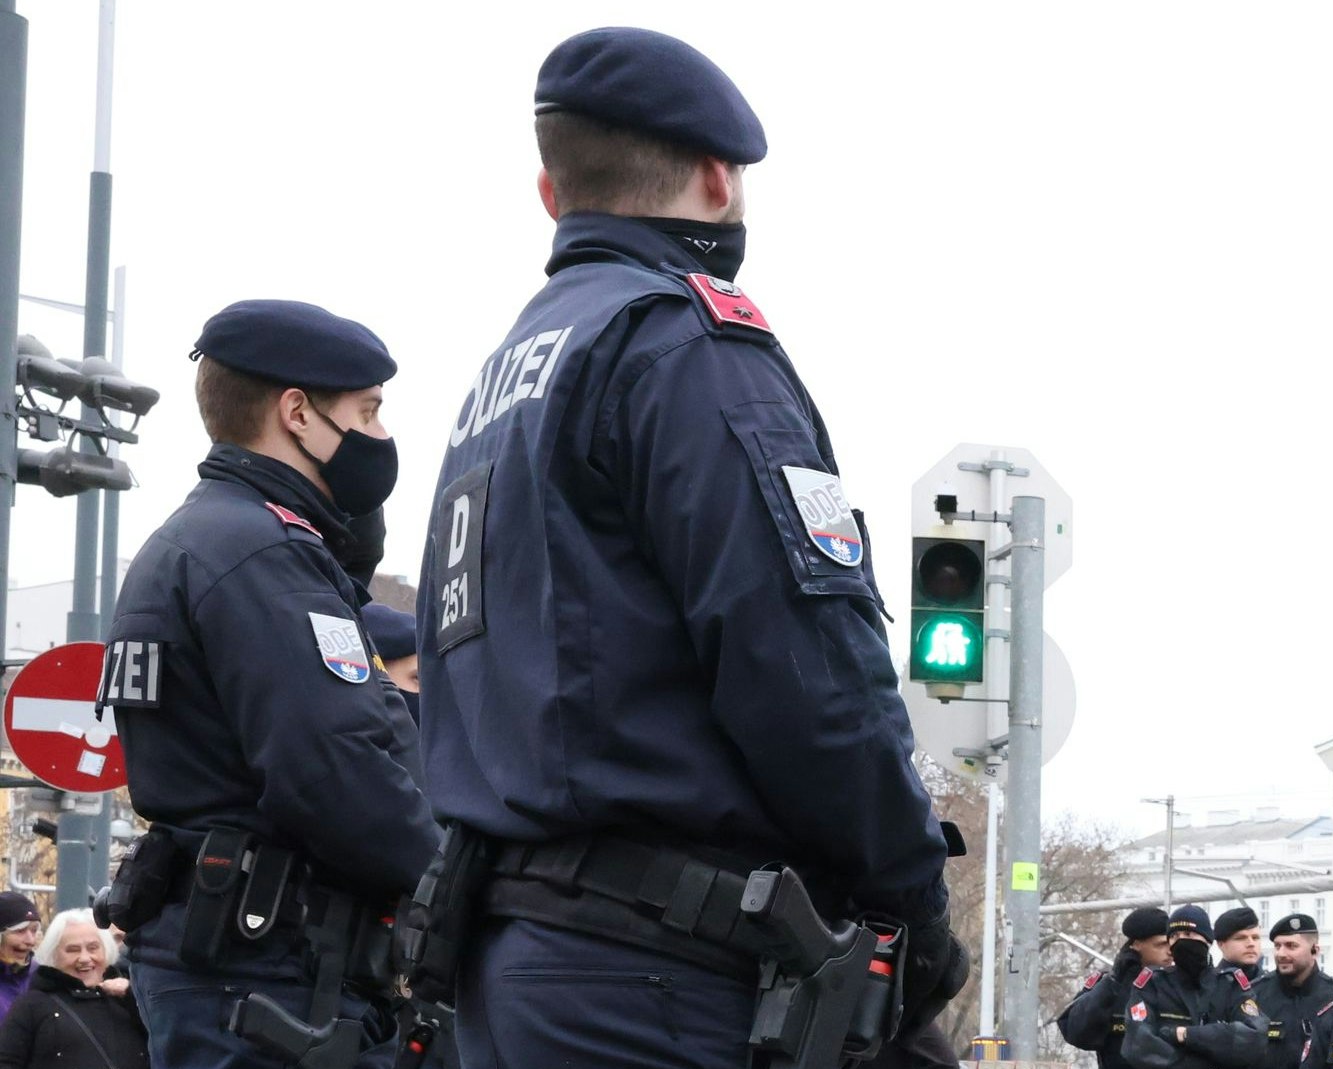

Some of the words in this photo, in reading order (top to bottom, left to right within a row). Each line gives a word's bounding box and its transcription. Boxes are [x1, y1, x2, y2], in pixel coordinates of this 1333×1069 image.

[451, 325, 574, 448] OLIZEI
[448, 494, 470, 569] D
[441, 571, 468, 630] 251
[96, 641, 159, 702] ZEI
